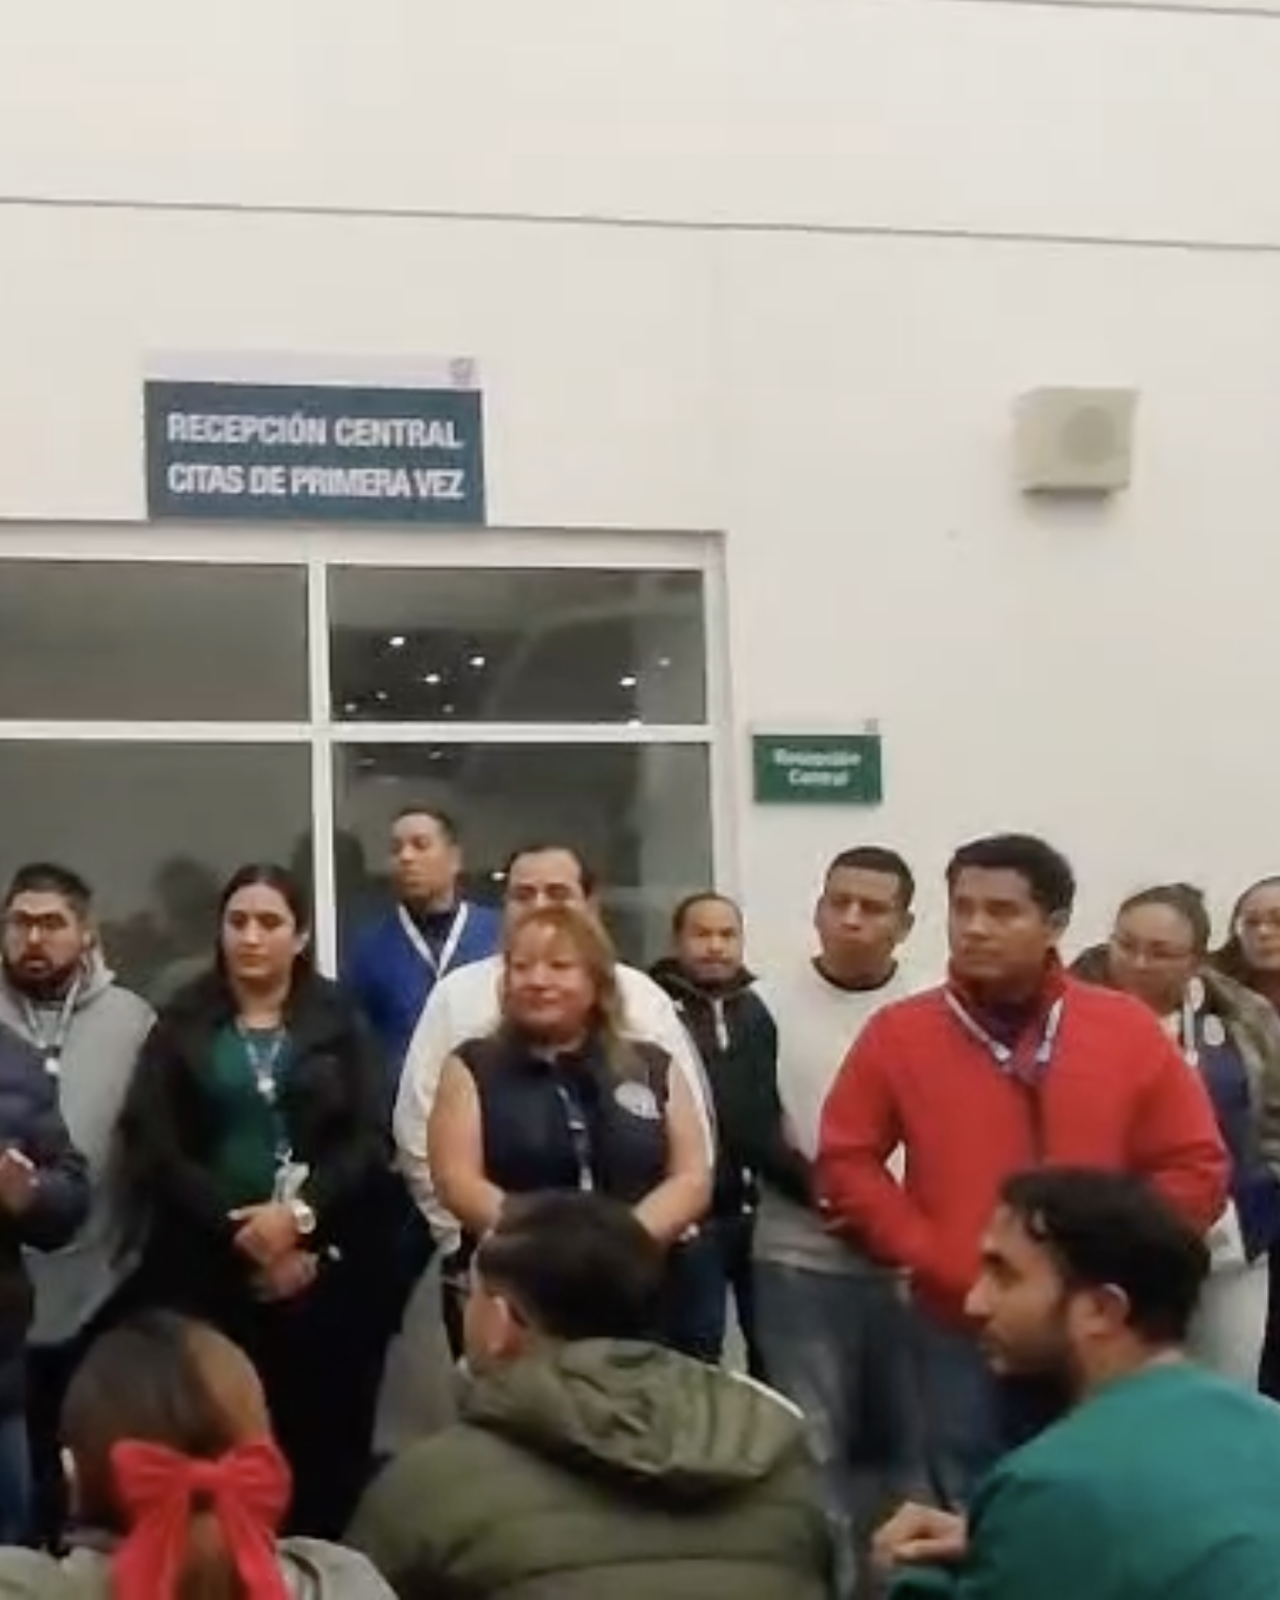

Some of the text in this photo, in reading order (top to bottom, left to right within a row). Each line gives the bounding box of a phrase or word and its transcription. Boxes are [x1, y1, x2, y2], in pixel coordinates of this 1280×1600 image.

[167, 411, 464, 448] RECEPCIÓN CENTRAL
[167, 463, 465, 499] CITAS DE PRIMERA VEZ
